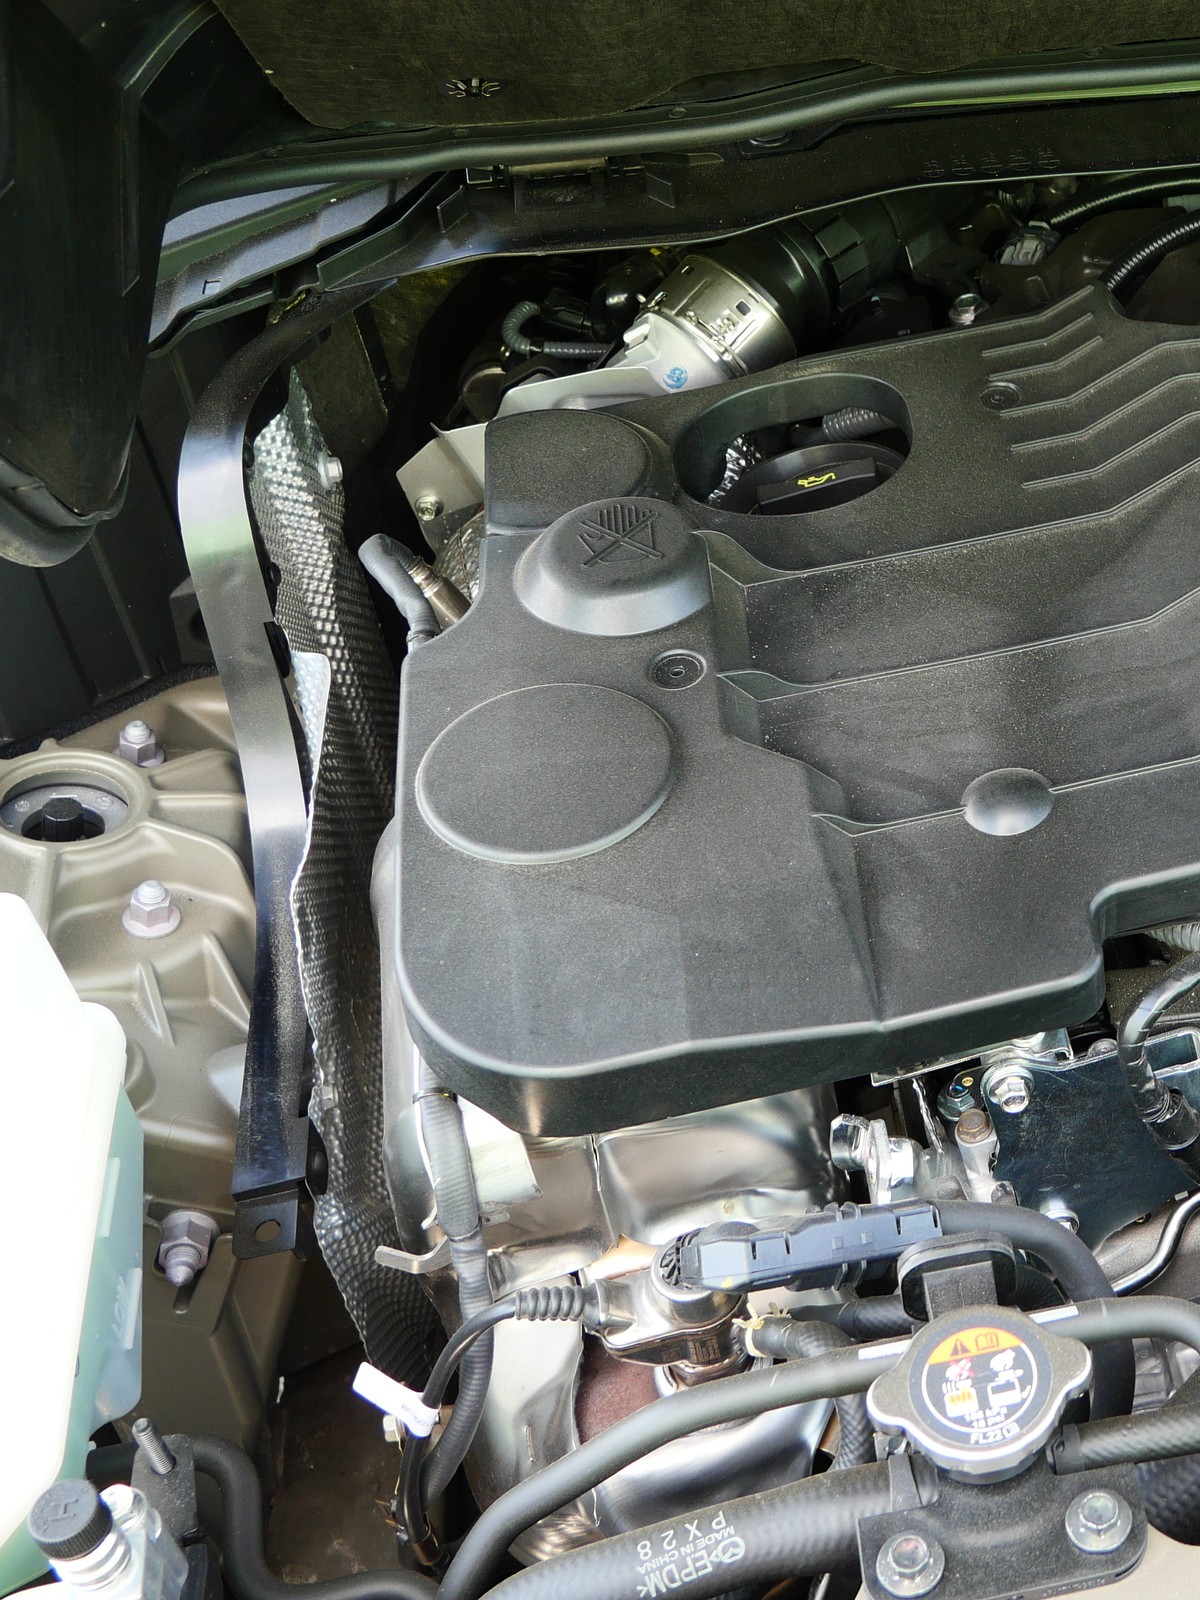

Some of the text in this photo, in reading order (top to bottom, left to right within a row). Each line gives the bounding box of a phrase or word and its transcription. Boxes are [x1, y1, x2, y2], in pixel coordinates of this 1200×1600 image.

[970, 1429, 1003, 1445] FL22
[637, 1525, 735, 1575] MADE IN CHINA
